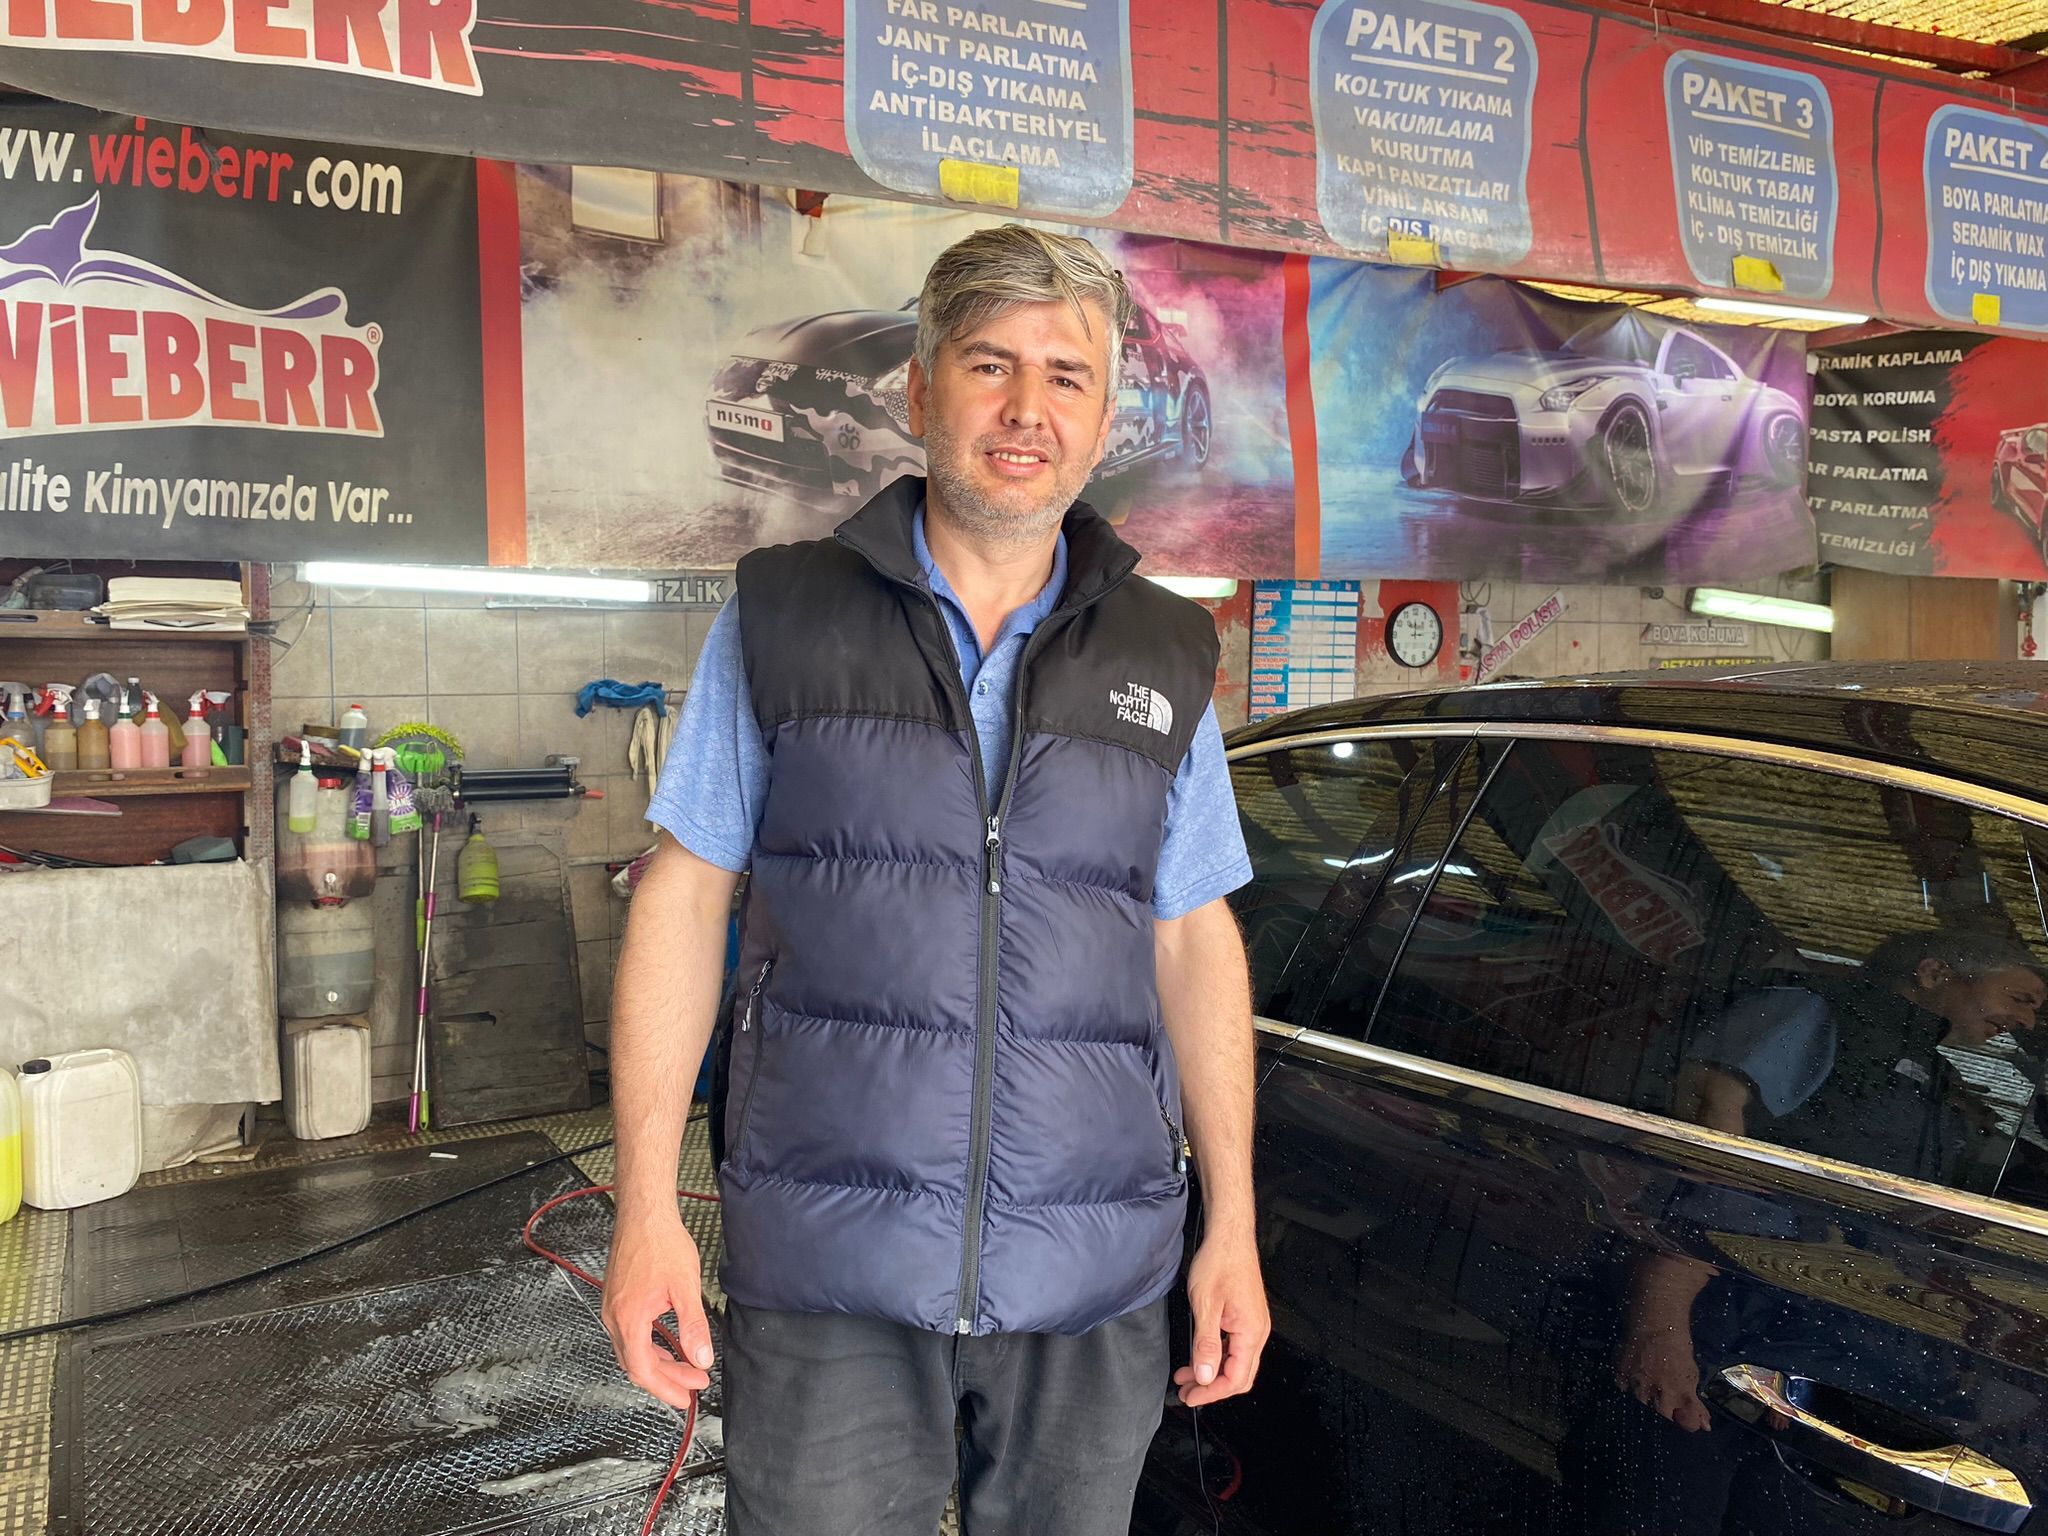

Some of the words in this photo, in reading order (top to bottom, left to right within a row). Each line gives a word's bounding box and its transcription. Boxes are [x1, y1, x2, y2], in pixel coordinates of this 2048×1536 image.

[887, 0, 939, 23] FAR
[946, 6, 1088, 50] PARLATMA
[1345, 8, 1482, 66] PAKET
[1493, 36, 1515, 72] 2
[877, 24, 950, 55] JANT
[960, 39, 1097, 83] PARLATMA
[891, 54, 973, 98] İÇ-DIŞ
[983, 75, 1087, 111] YIKAMA
[1334, 73, 1431, 105] KOLTUK
[1438, 87, 1513, 118] YIKAMA
[1682, 72, 1787, 123] PAKET
[1796, 98, 1814, 129] 3
[870, 89, 1106, 144] ANTİBAKTERİYEL
[1353, 106, 1495, 143] VAKUMLAMA
[922, 126, 1060, 168] İLAÇLAMA
[1370, 137, 1474, 169] KURUTMA
[1688, 135, 1714, 157] VİP
[1718, 143, 1816, 176] TEMİZLEME
[1944, 128, 2034, 171] PAKET
[1691, 165, 1753, 195] KOLTUK
[1757, 180, 1815, 205] TABAN
[1688, 191, 1736, 219] KLİMA
[1942, 186, 1981, 212] BOYA
[1984, 193, 2048, 225] PARLATMA
[1748, 232, 1818, 261] TEMİZLİK
[1952, 222, 2013, 252] SERAMİK
[2016, 233, 2045, 258] WAX
[1995, 262, 2047, 292] YIKAMA
[1819, 352, 1873, 371] RAMİK
[1877, 349, 1963, 368] KAPLAMA
[1813, 393, 1858, 407] BOYA
[1863, 390, 1936, 405] KORUMA
[1809, 427, 1862, 443] PASTA
[1832, 464, 1928, 481] PARLATMA
[1830, 500, 1929, 520] PARLATMA
[1652, 625, 1687, 643] BOYA
[1690, 626, 1745, 645] KORUMA
[1109, 689, 1149, 713] NORTH
[1127, 682, 1150, 700] THE
[1116, 706, 1148, 726] FACE
